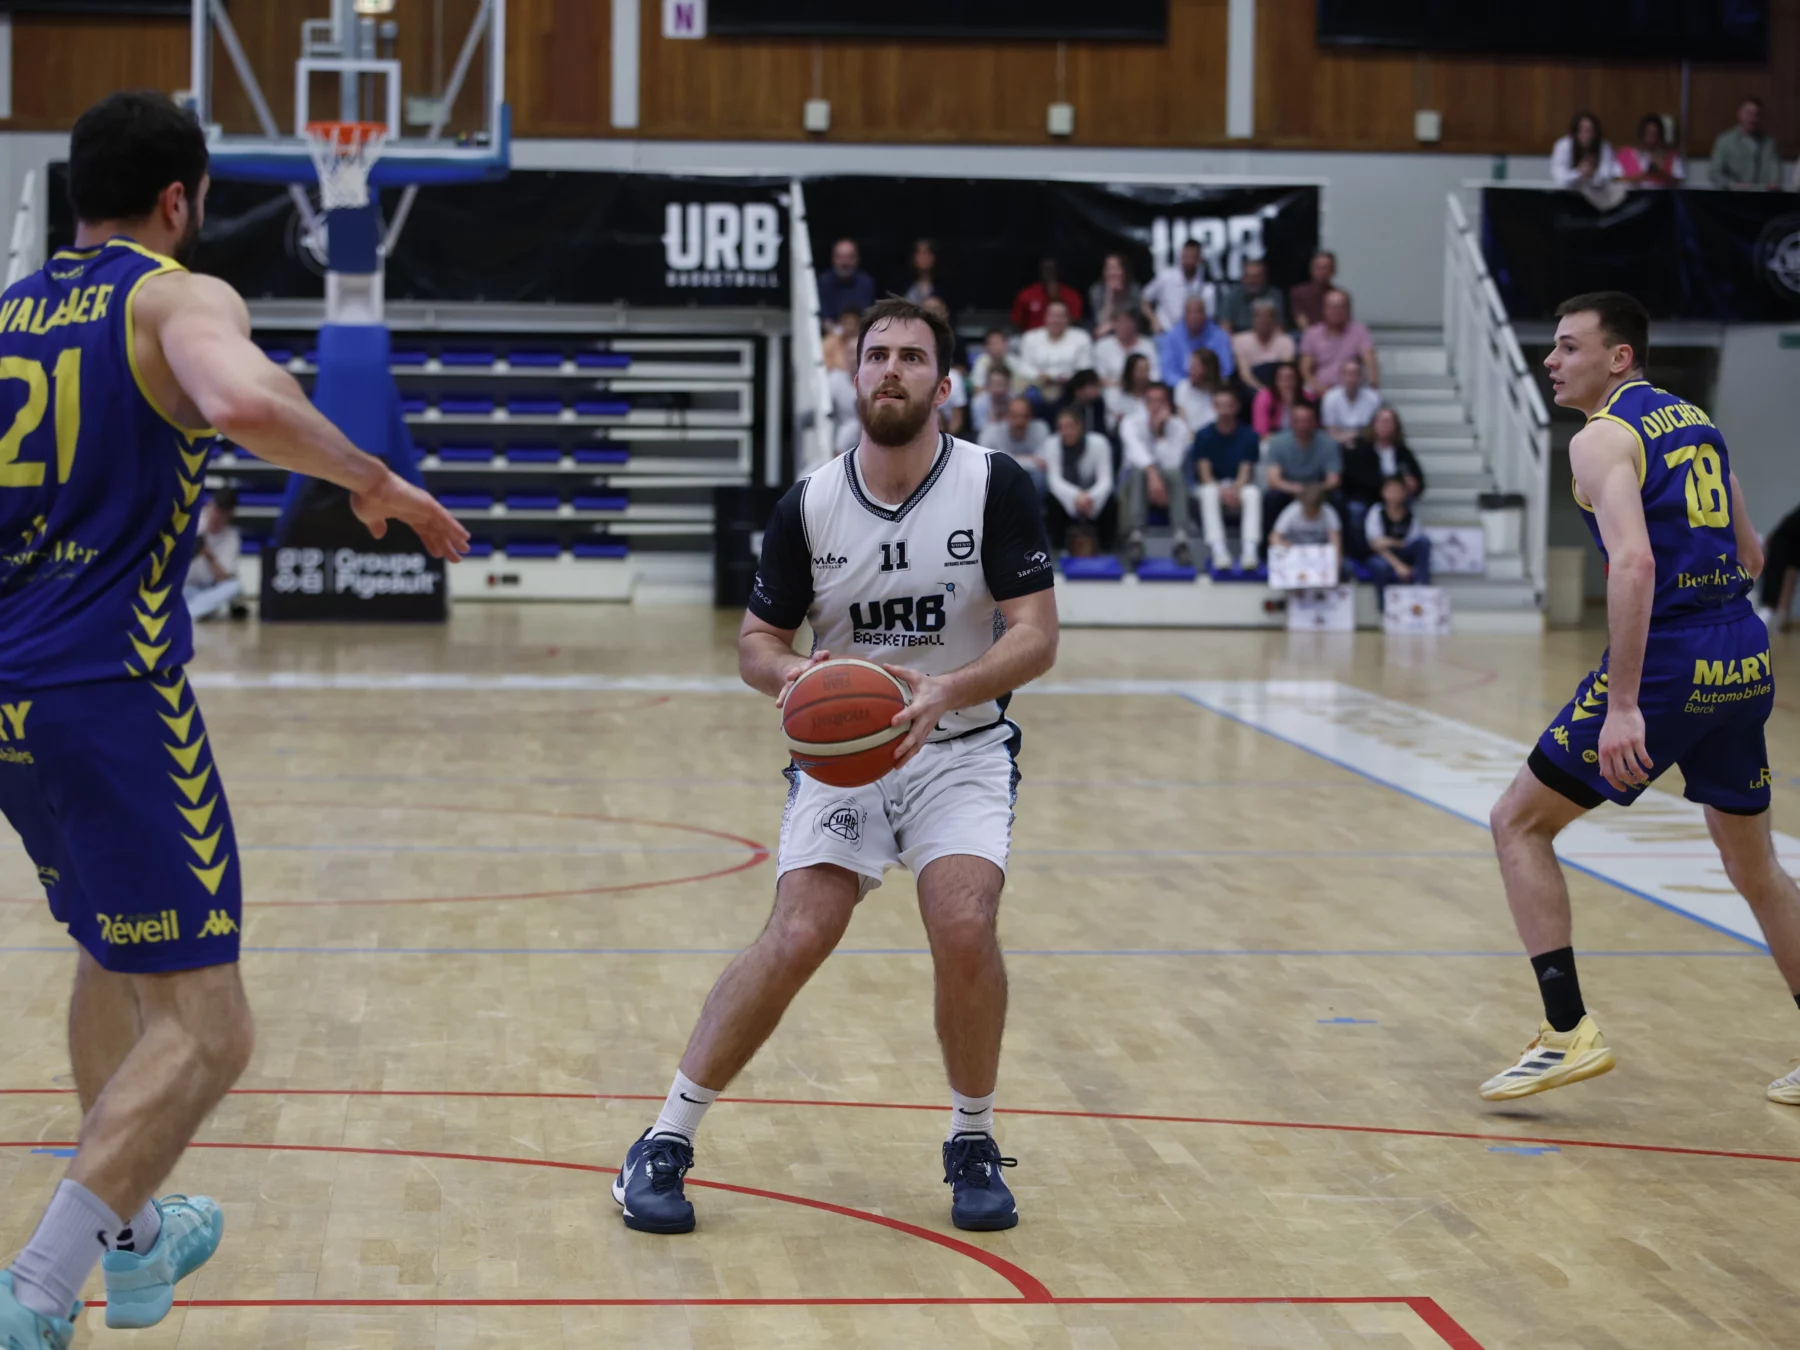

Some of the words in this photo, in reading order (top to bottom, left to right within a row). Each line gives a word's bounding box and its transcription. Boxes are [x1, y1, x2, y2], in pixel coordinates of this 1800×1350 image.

[674, 2, 695, 31] N
[661, 201, 782, 271] URB
[0, 347, 82, 488] 21
[1663, 443, 1731, 529] 78
[878, 539, 911, 574] 11
[950, 541, 972, 549] VOLVO
[334, 548, 426, 574] Groupe
[334, 572, 437, 599] Pigeault
[849, 594, 946, 632] URB
[853, 632, 945, 647] BASKETBALL
[1688, 683, 1771, 703] Automobiles
[1684, 702, 1715, 714] Berck
[97, 909, 180, 945] Réveil
